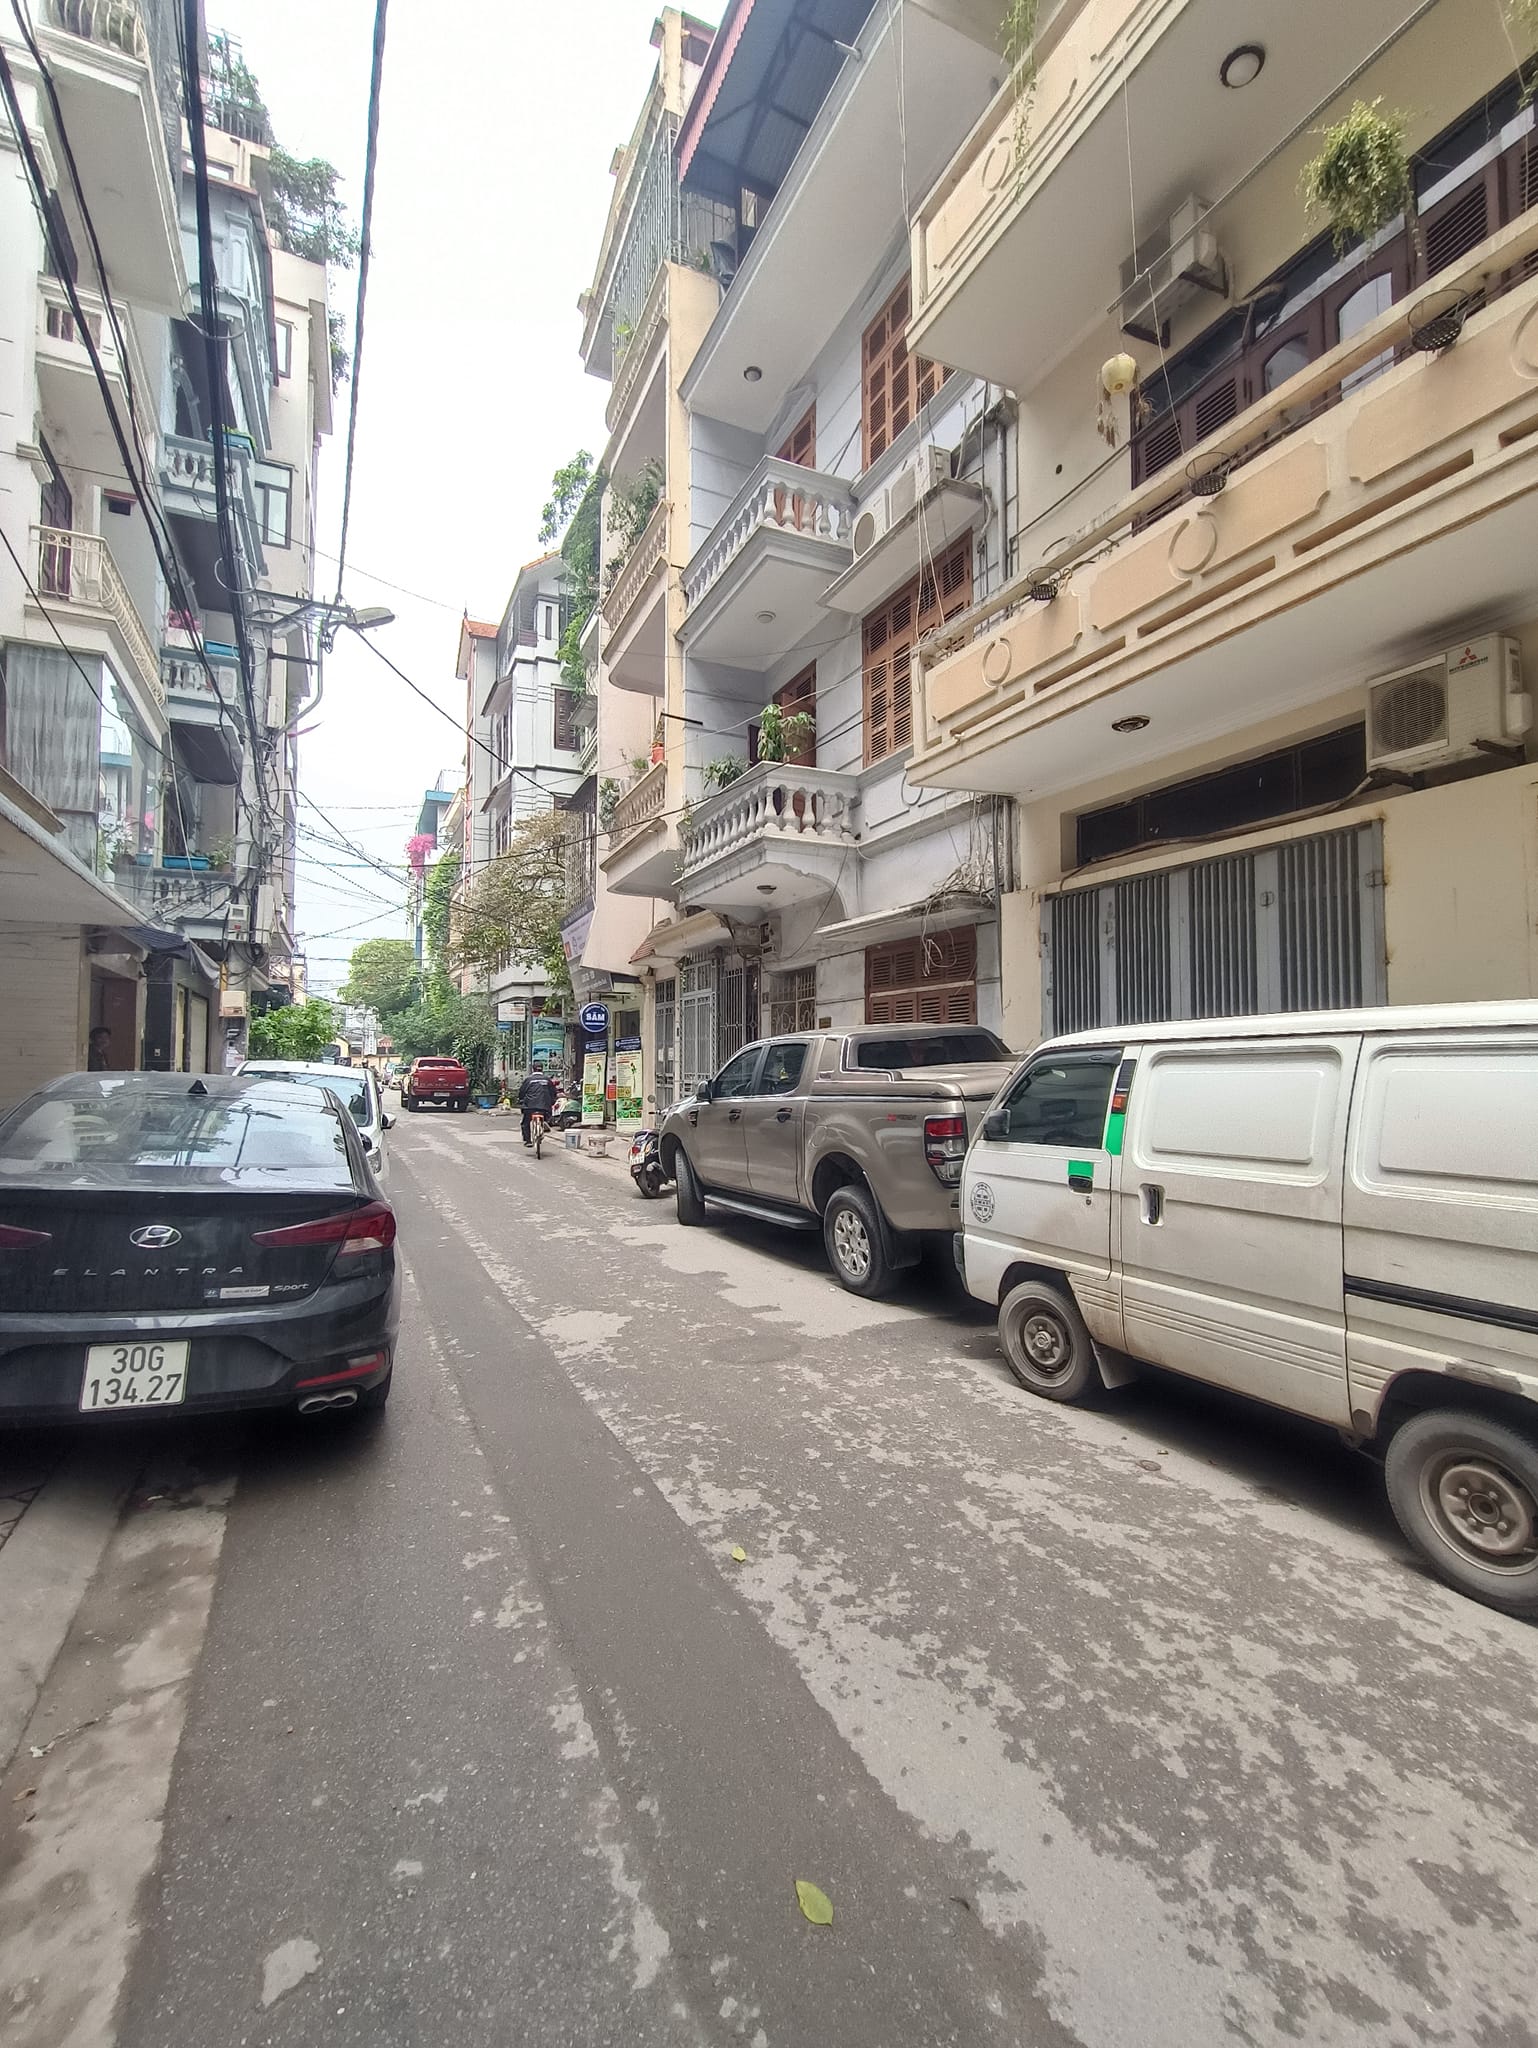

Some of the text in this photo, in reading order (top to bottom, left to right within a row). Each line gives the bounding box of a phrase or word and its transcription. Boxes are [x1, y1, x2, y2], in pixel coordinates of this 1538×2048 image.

[52, 1266, 244, 1277] ELANTRA
[272, 1283, 310, 1293] Sport
[110, 1345, 165, 1375] 30G
[90, 1373, 182, 1407] 134.27
